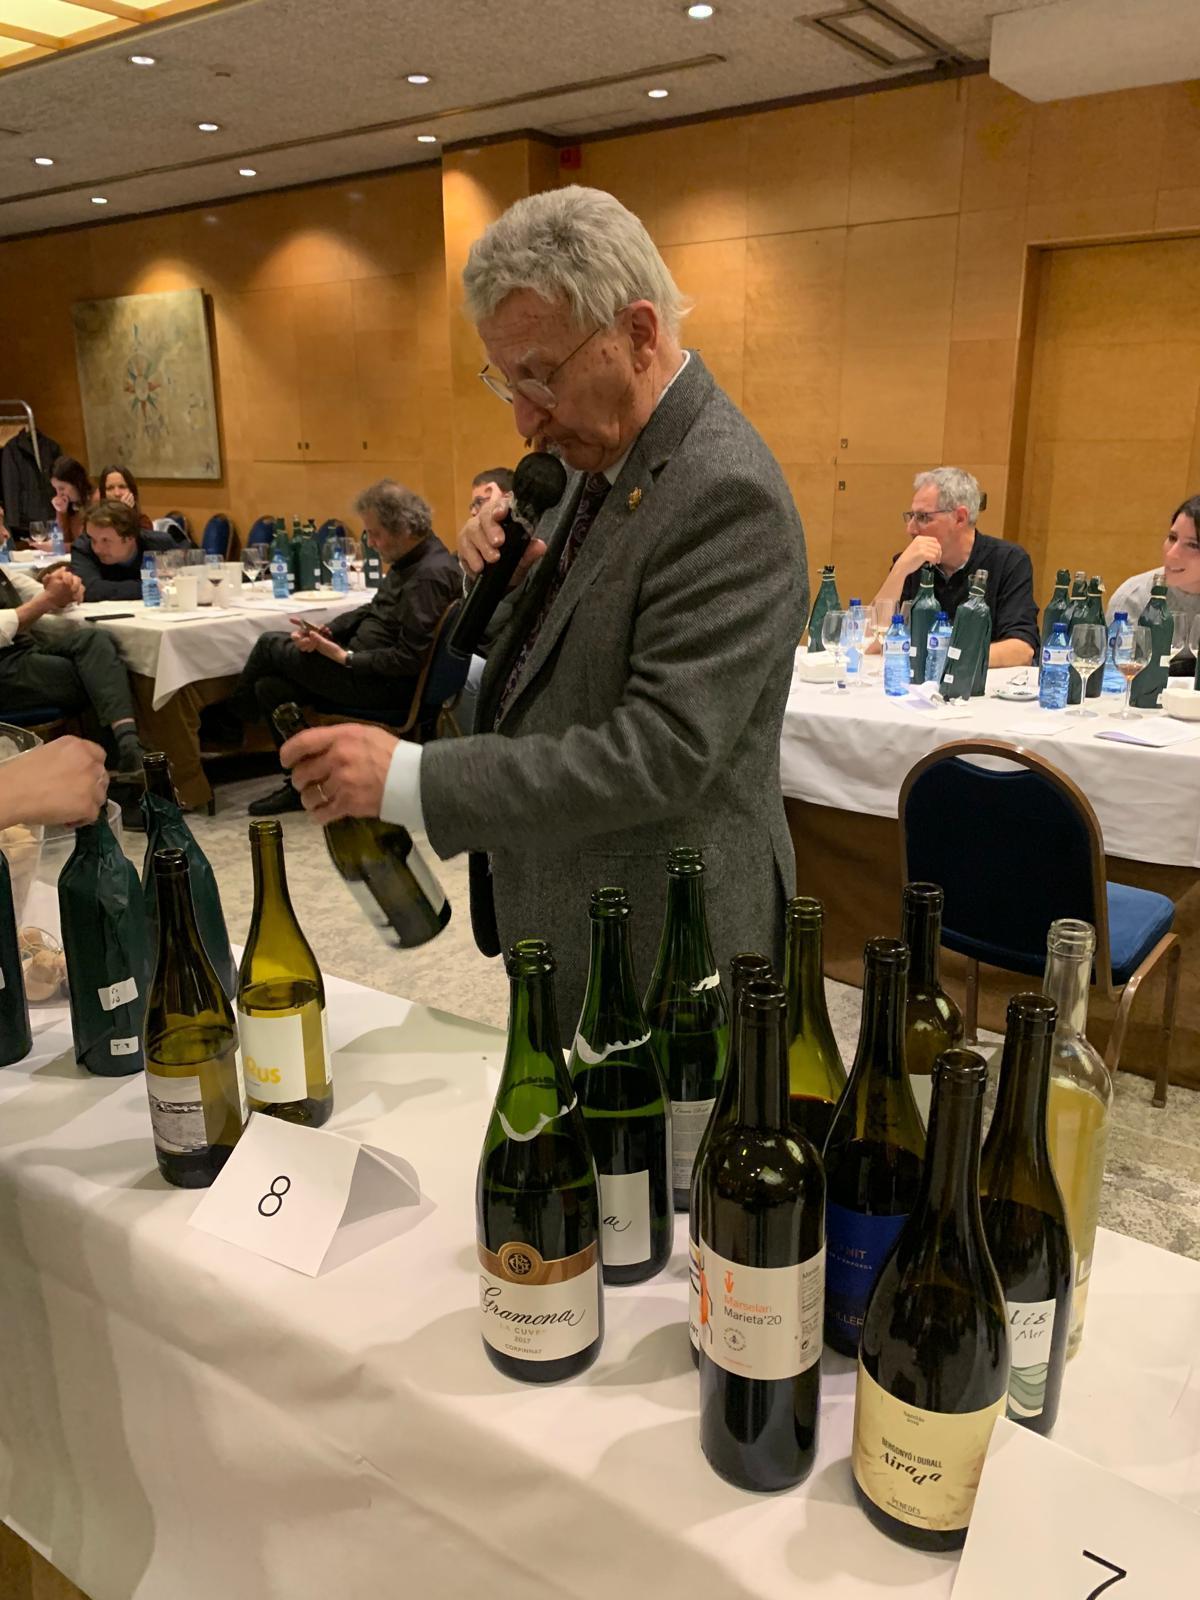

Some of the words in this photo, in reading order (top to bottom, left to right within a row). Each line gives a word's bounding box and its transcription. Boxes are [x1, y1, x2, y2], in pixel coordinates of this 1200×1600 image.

[258, 1175, 291, 1217] 8
[480, 1275, 586, 1327] Gramona
[723, 1305, 782, 1326] Marieta'20
[880, 1451, 943, 1486] Airada
[1082, 1549, 1127, 1600] 7
